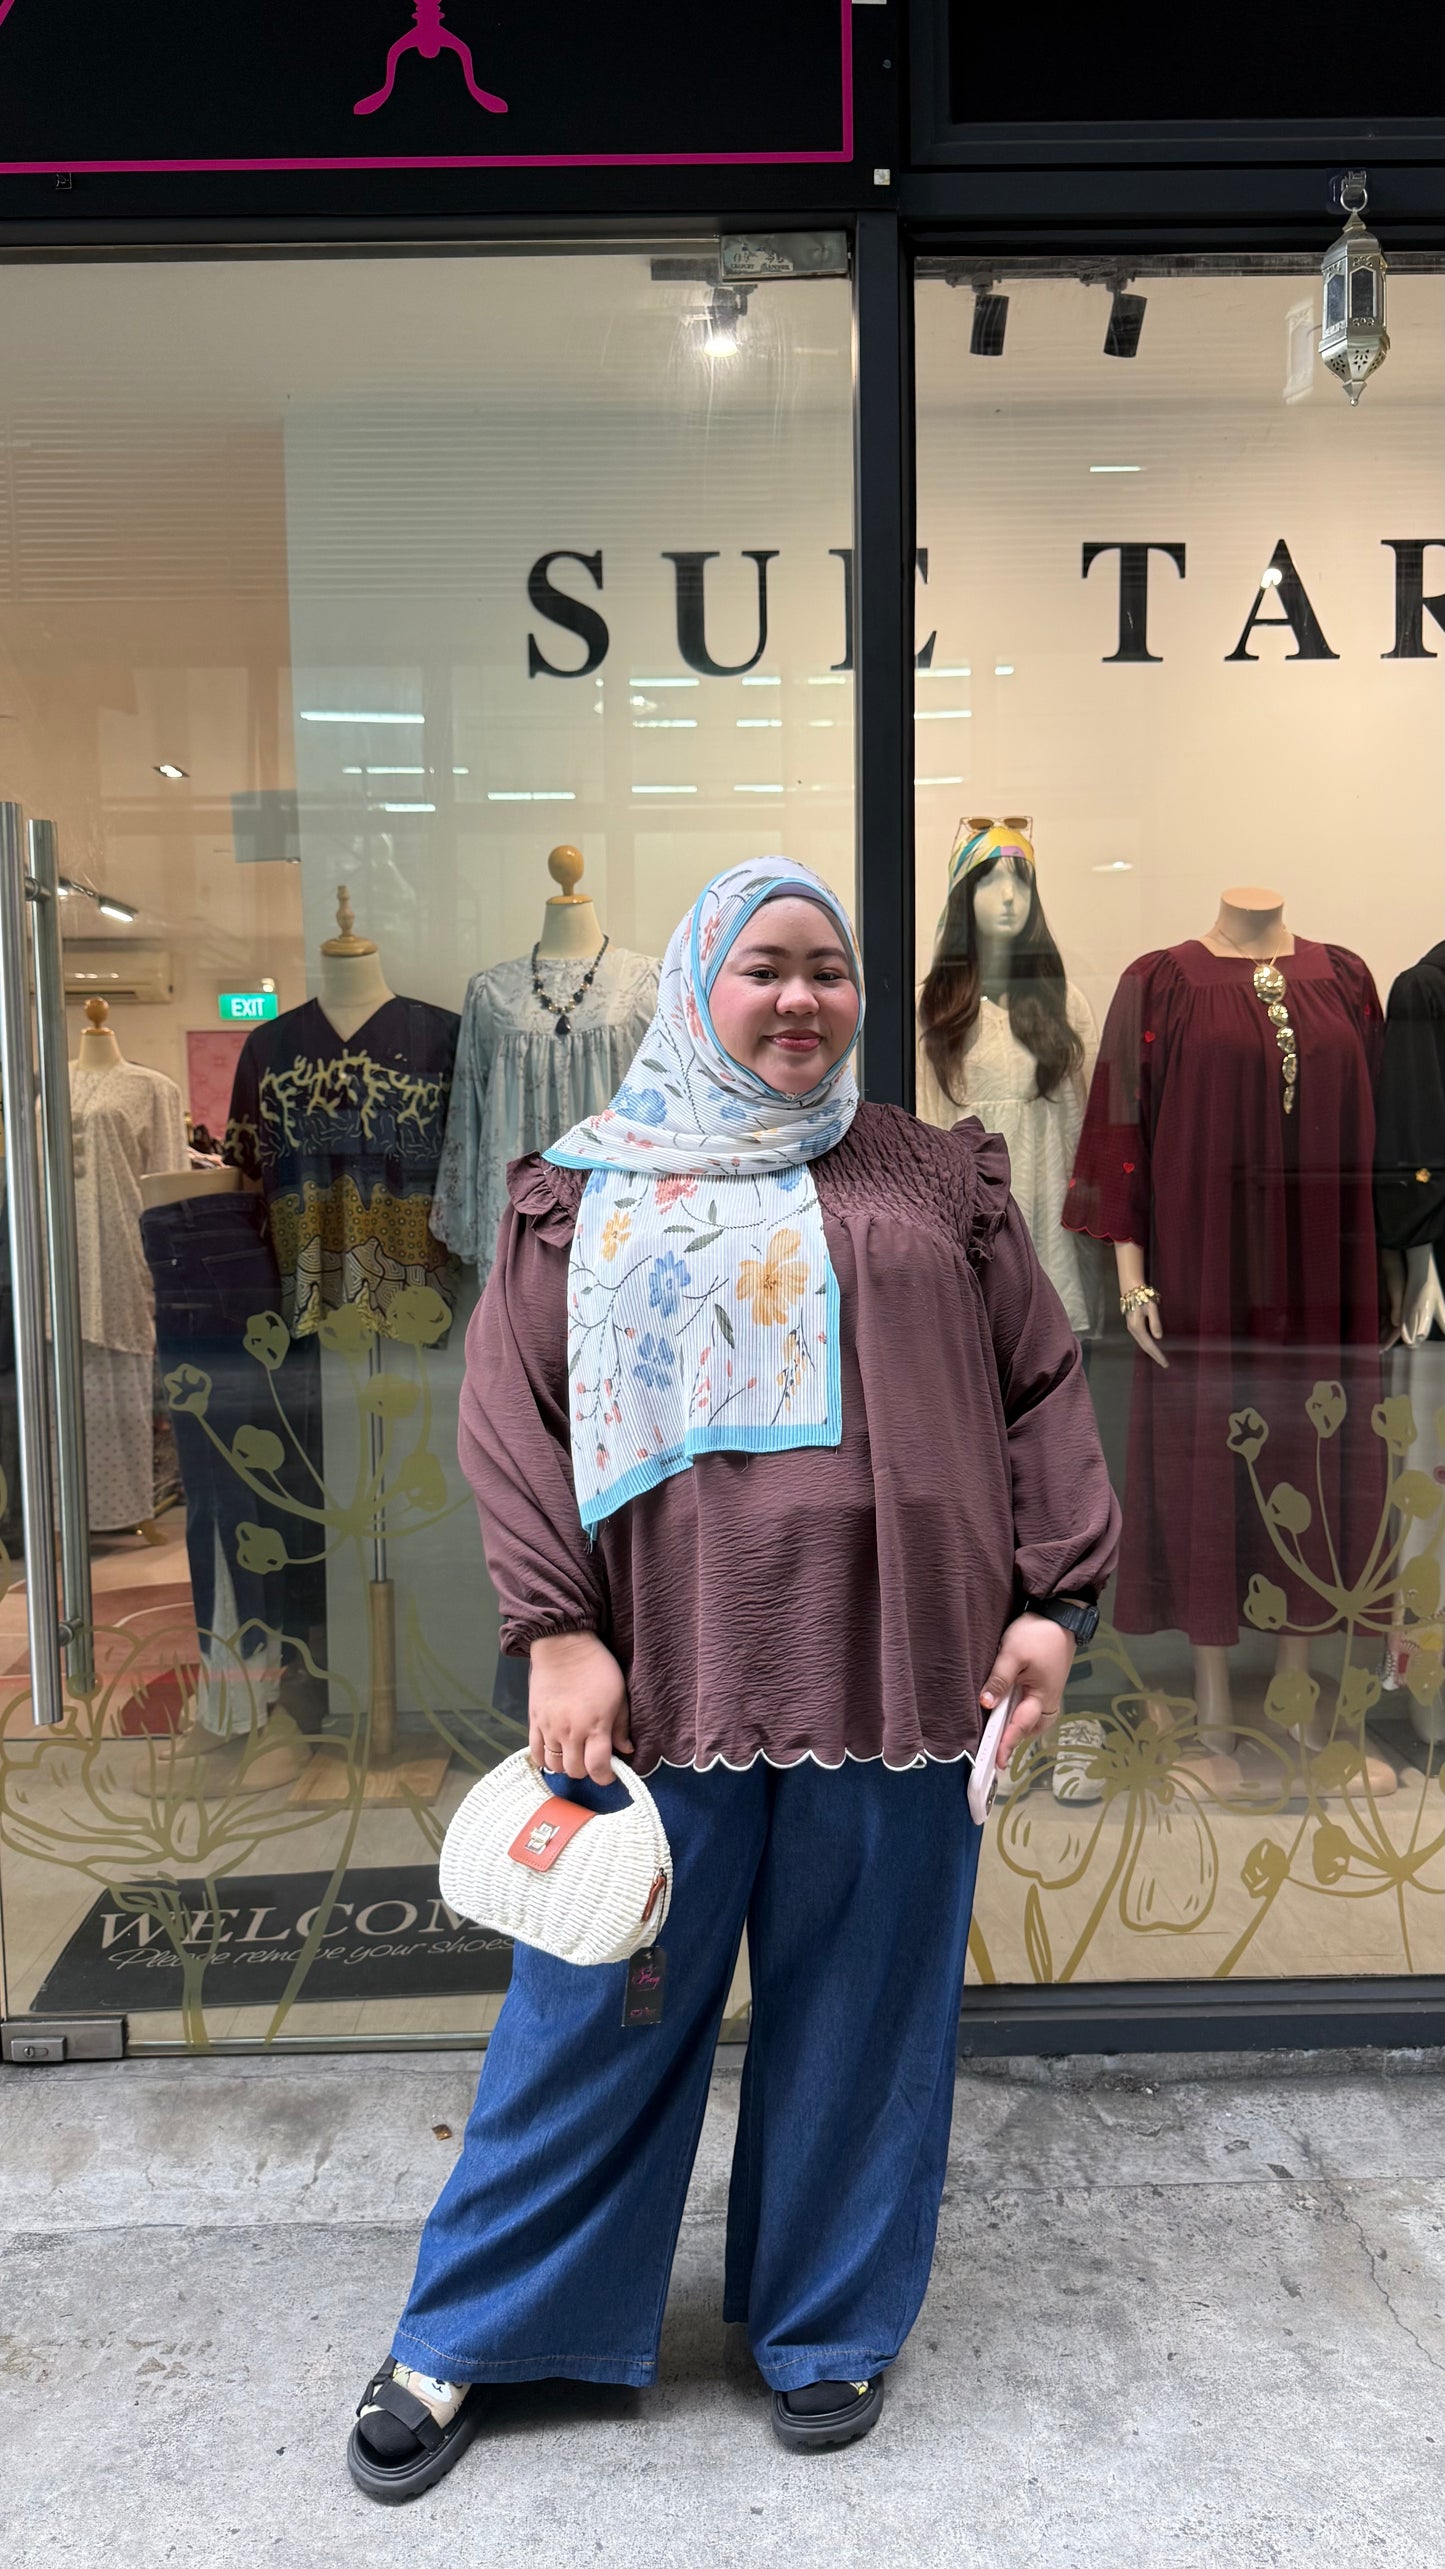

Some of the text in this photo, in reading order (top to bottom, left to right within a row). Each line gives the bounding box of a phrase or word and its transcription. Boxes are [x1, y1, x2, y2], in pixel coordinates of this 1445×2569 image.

[231, 998, 265, 1017] EXIT
[343, 1942, 426, 1964] your
[427, 1935, 515, 1954] shoes
